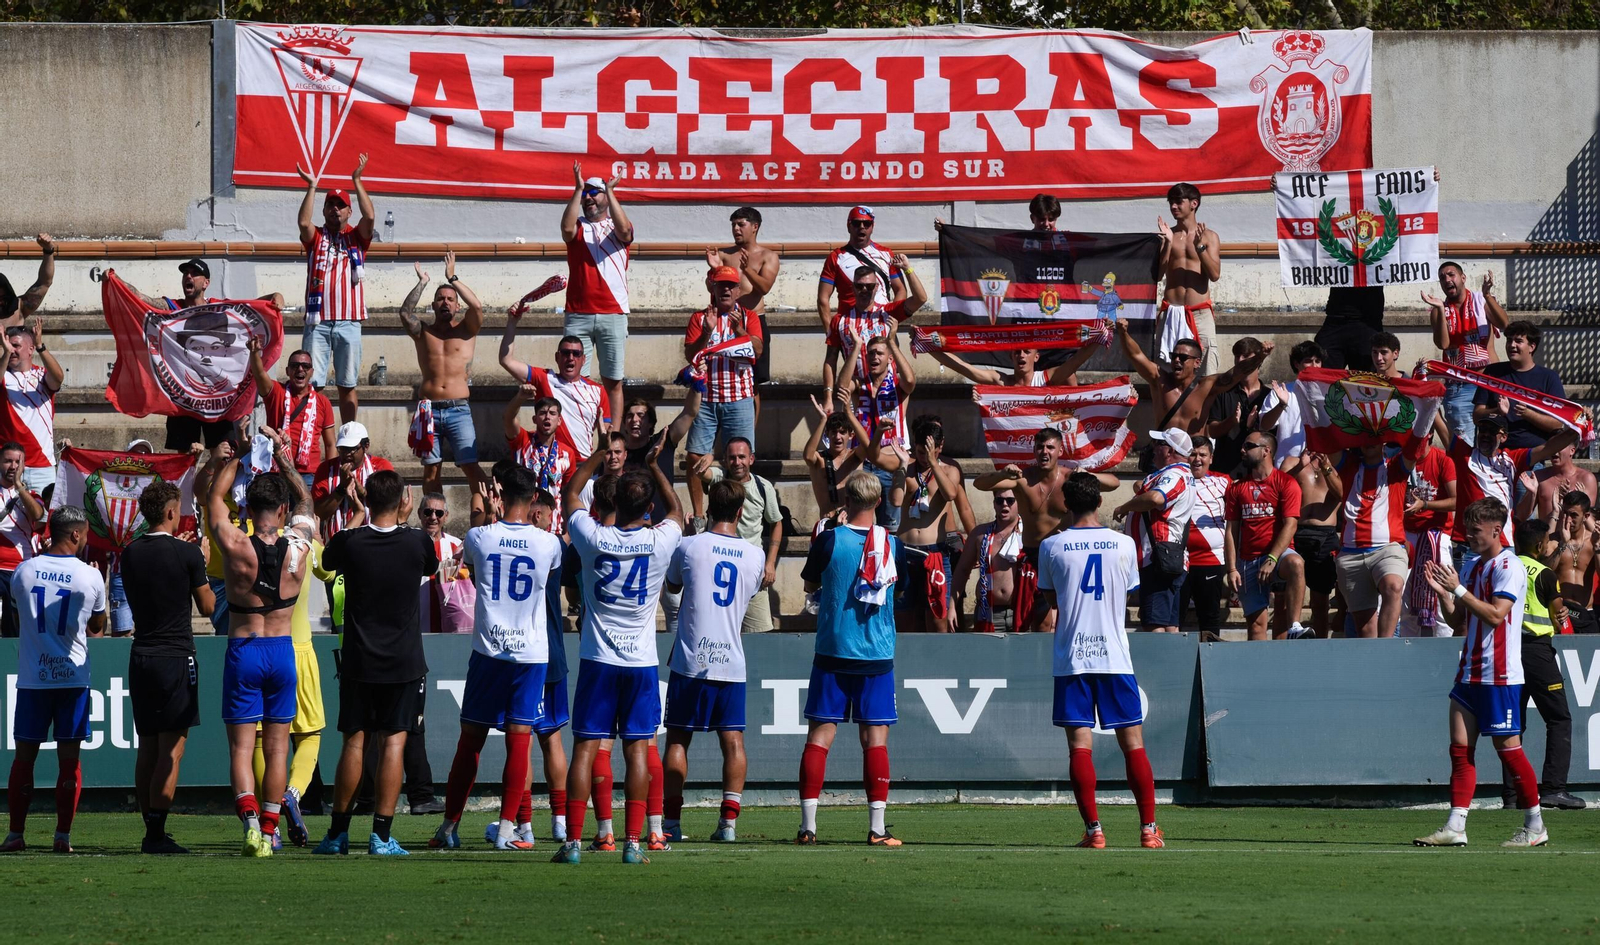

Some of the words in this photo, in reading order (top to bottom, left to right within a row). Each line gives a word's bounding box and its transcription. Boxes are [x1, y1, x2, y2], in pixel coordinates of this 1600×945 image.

[295, 82, 331, 91] ALGECIRAS
[395, 51, 1220, 155] ALGECIRAS
[611, 160, 721, 182] GRADA
[739, 160, 801, 181] ACF
[819, 160, 925, 181] FONDO
[943, 158, 1006, 178] SUR
[1291, 174, 1329, 199] ACF
[1375, 169, 1426, 197] FANS
[1291, 221, 1315, 236] 19
[1403, 216, 1424, 231] 12
[1036, 266, 1065, 280] 11205
[1291, 264, 1349, 286] BARRIO
[1374, 261, 1431, 284] C.RAYO
[974, 331, 1009, 339] PARTE
[1011, 330, 1031, 338] DEL
[1033, 328, 1064, 336] ÉXITO
[1446, 368, 1538, 400] ALGECIRAS
[1541, 396, 1565, 410] CF
[498, 537, 529, 549] ÁNGEL
[624, 543, 654, 553] CASTRO
[1063, 541, 1089, 552] ALEIX
[1093, 540, 1119, 550] COCH
[712, 545, 743, 558] MANIN
[35, 570, 72, 583] TOMÁS
[486, 553, 536, 602] 16
[594, 554, 650, 606] 24
[713, 560, 738, 607] 9
[1080, 553, 1105, 601] 4
[30, 586, 71, 636] 11
[502, 640, 526, 651] Gusta
[1085, 646, 1108, 658] Gusta
[708, 651, 730, 664] Gusta
[52, 667, 75, 679] Gusta
